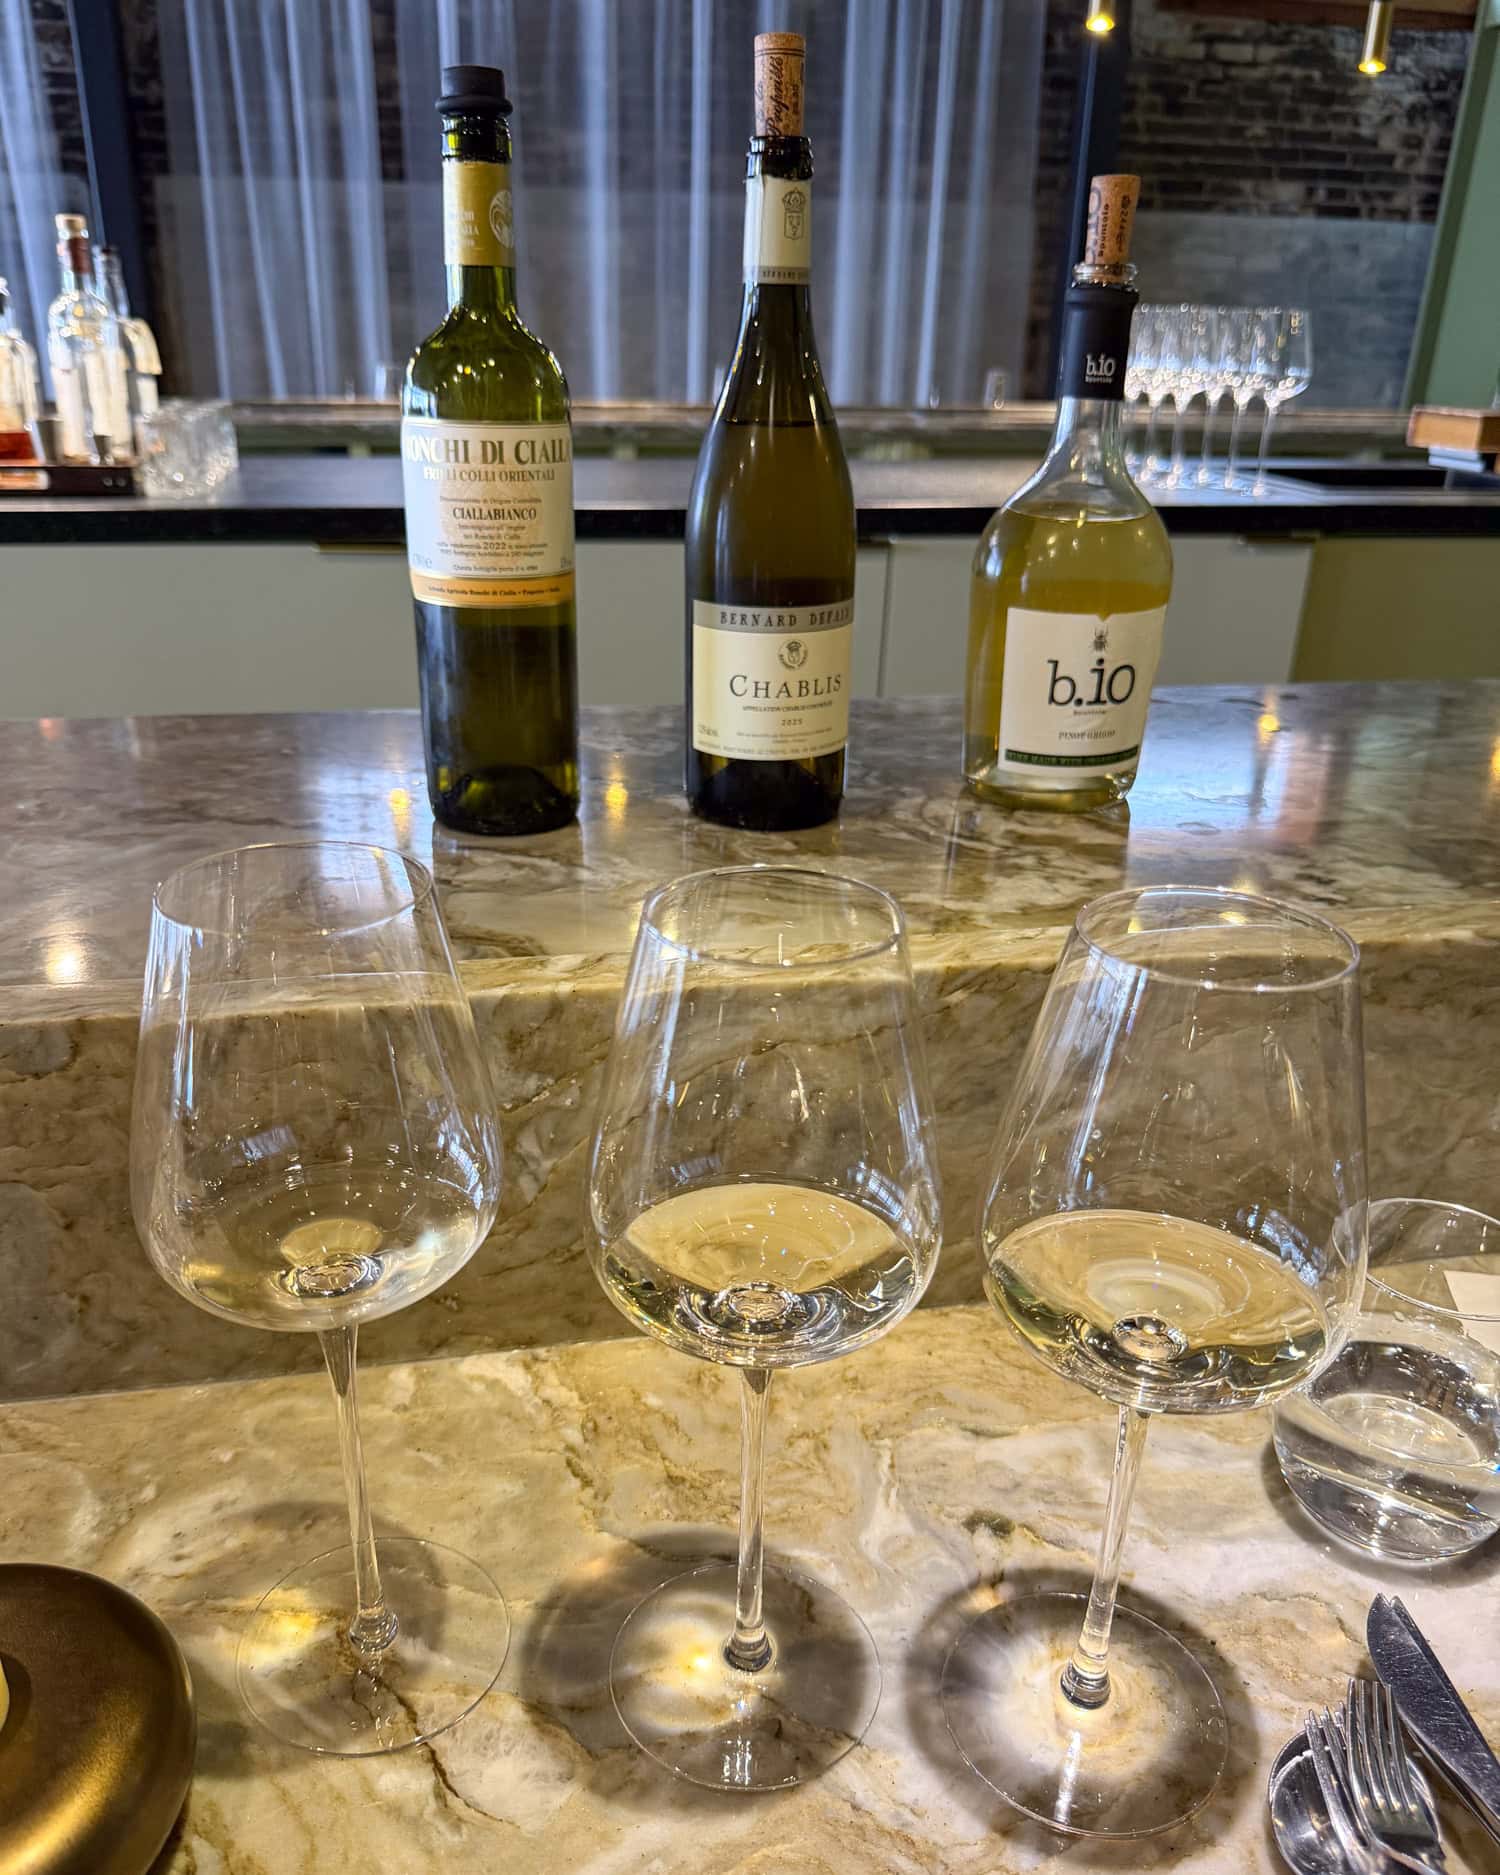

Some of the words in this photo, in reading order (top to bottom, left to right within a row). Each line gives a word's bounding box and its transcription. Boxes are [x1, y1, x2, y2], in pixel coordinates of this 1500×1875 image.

[480, 440, 505, 465] DI
[460, 469, 498, 482] COLLI
[499, 468, 555, 482] ORIENTALI
[453, 507, 537, 521] CIALLABIANCO
[483, 541, 507, 550] 2022
[720, 611, 797, 627] BERNARD
[1047, 658, 1136, 707] b.io
